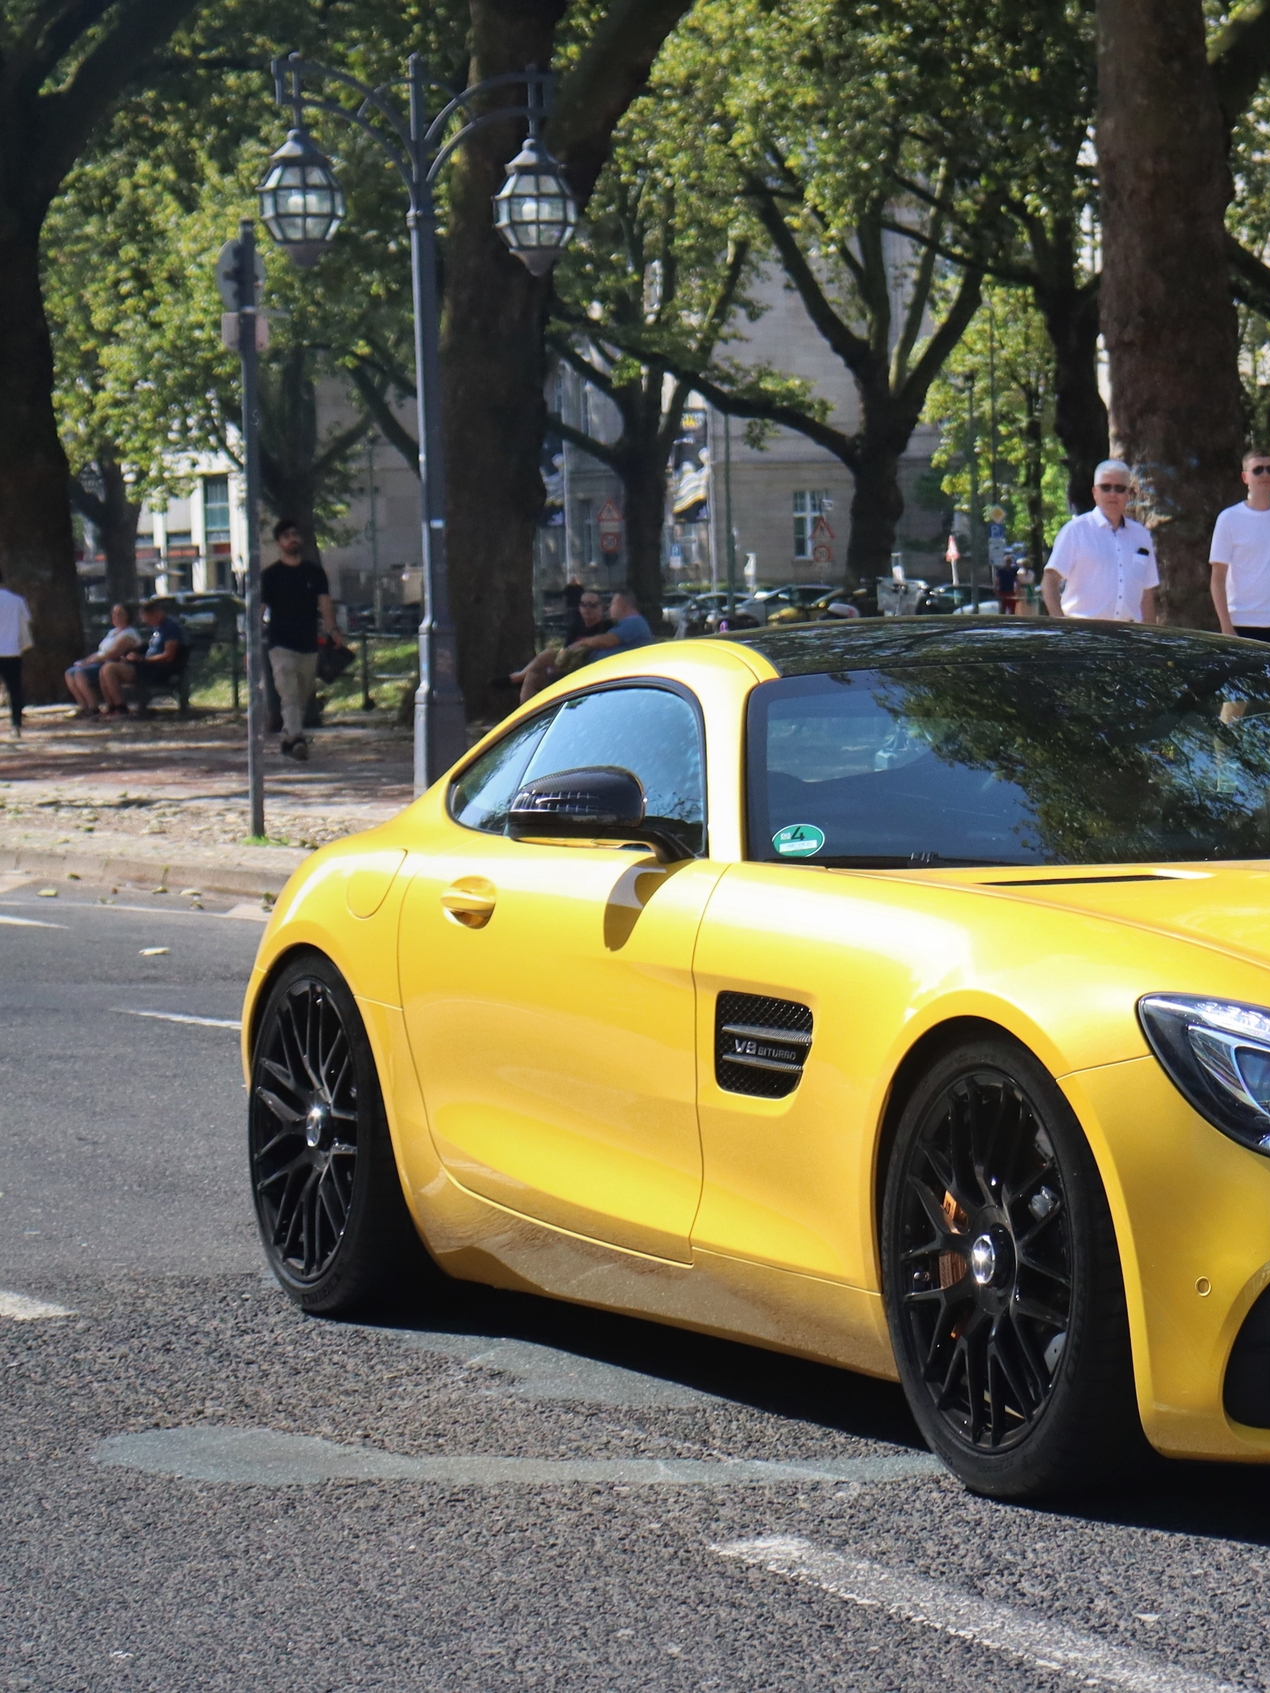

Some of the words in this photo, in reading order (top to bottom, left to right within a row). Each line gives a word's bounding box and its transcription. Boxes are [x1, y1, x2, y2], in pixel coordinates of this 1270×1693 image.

[790, 826, 805, 841] 4
[734, 1038, 757, 1055] V8
[757, 1046, 797, 1060] BITURBO
